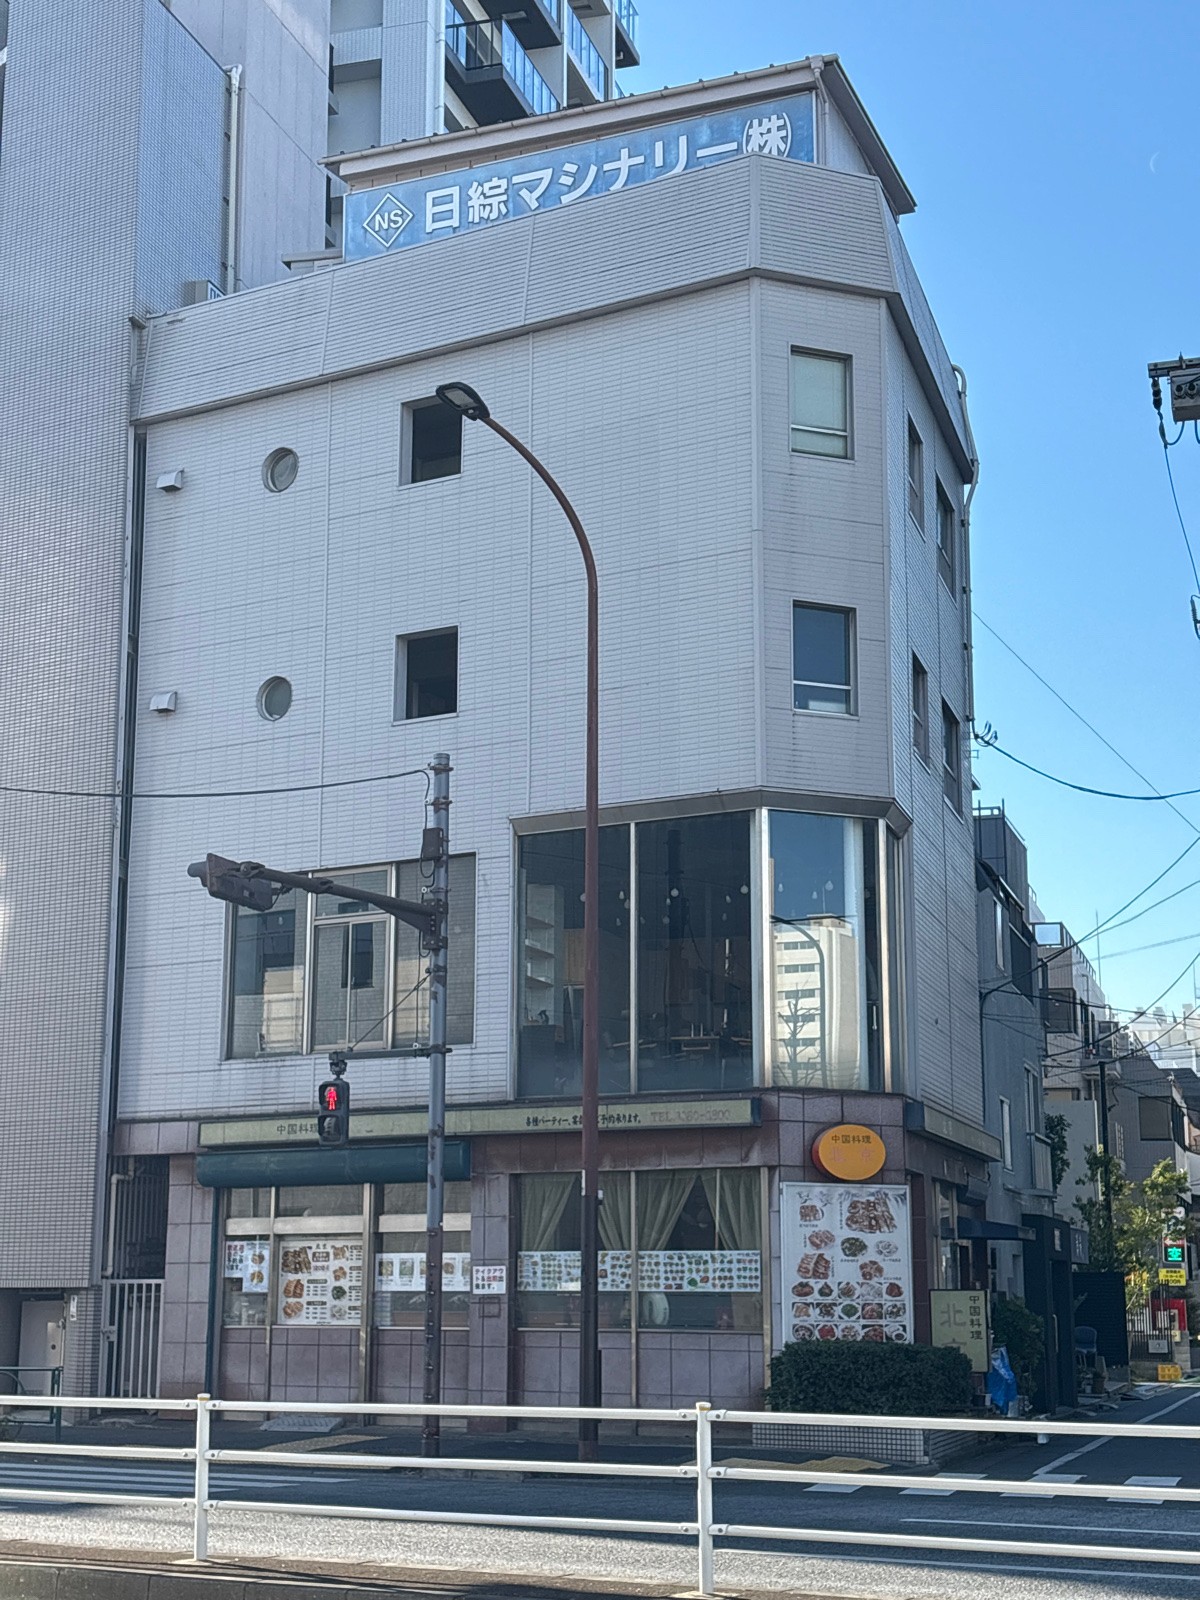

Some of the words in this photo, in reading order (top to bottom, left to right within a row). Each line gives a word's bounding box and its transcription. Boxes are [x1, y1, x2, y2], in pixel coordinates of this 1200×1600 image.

[373, 209, 403, 231] NS
[831, 1134, 872, 1144] 中国料理
[969, 1295, 984, 1340] 中国料理
